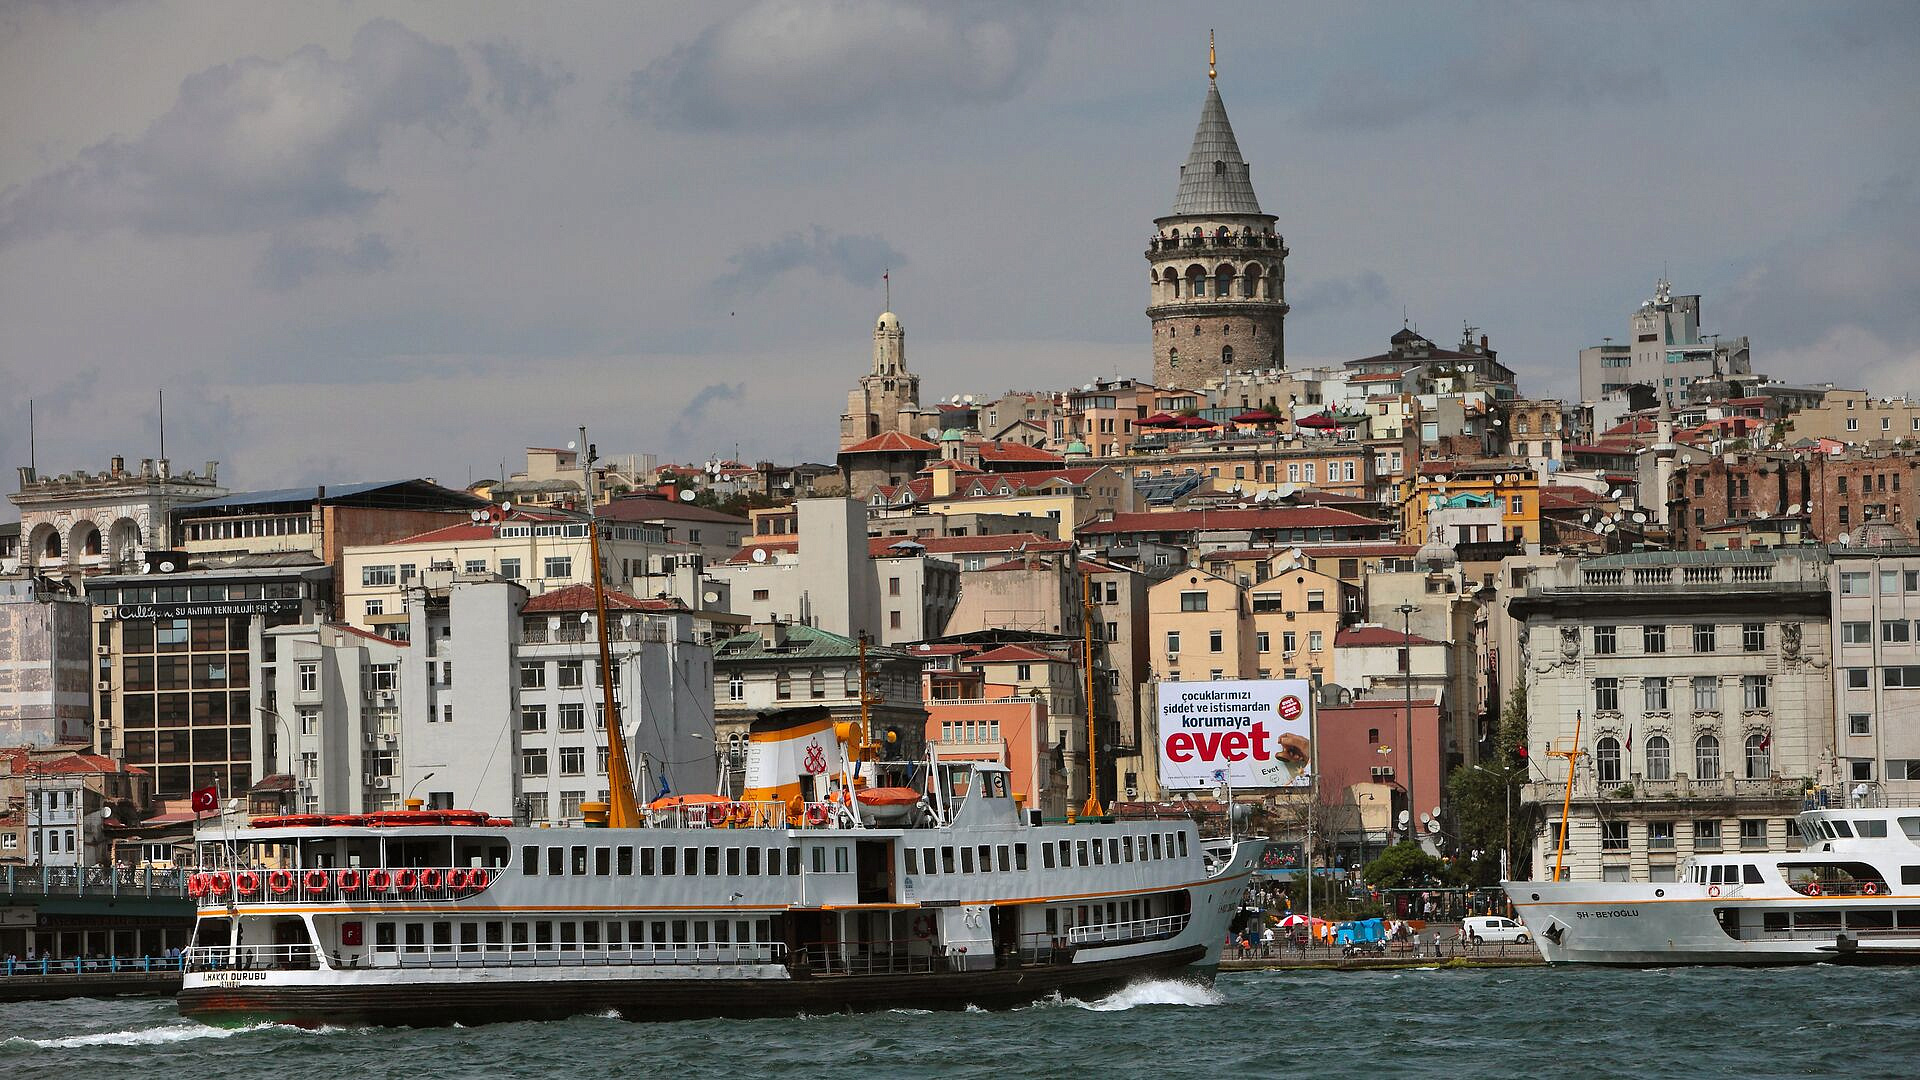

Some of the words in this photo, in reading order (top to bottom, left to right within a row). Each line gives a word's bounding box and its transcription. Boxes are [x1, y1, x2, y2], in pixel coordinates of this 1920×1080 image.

[175, 607, 186, 616] SU
[1181, 690, 1251, 703] çocuklarımızı
[1163, 703, 1194, 715] şiddet
[1197, 705, 1208, 713] ve
[1210, 702, 1270, 713] istismardan
[1182, 715, 1250, 729] korumaya
[1165, 721, 1271, 763] evet
[1261, 765, 1280, 776] Evet
[1595, 909, 1639, 918] BEYOĞLU
[230, 972, 267, 981] DURUBU
